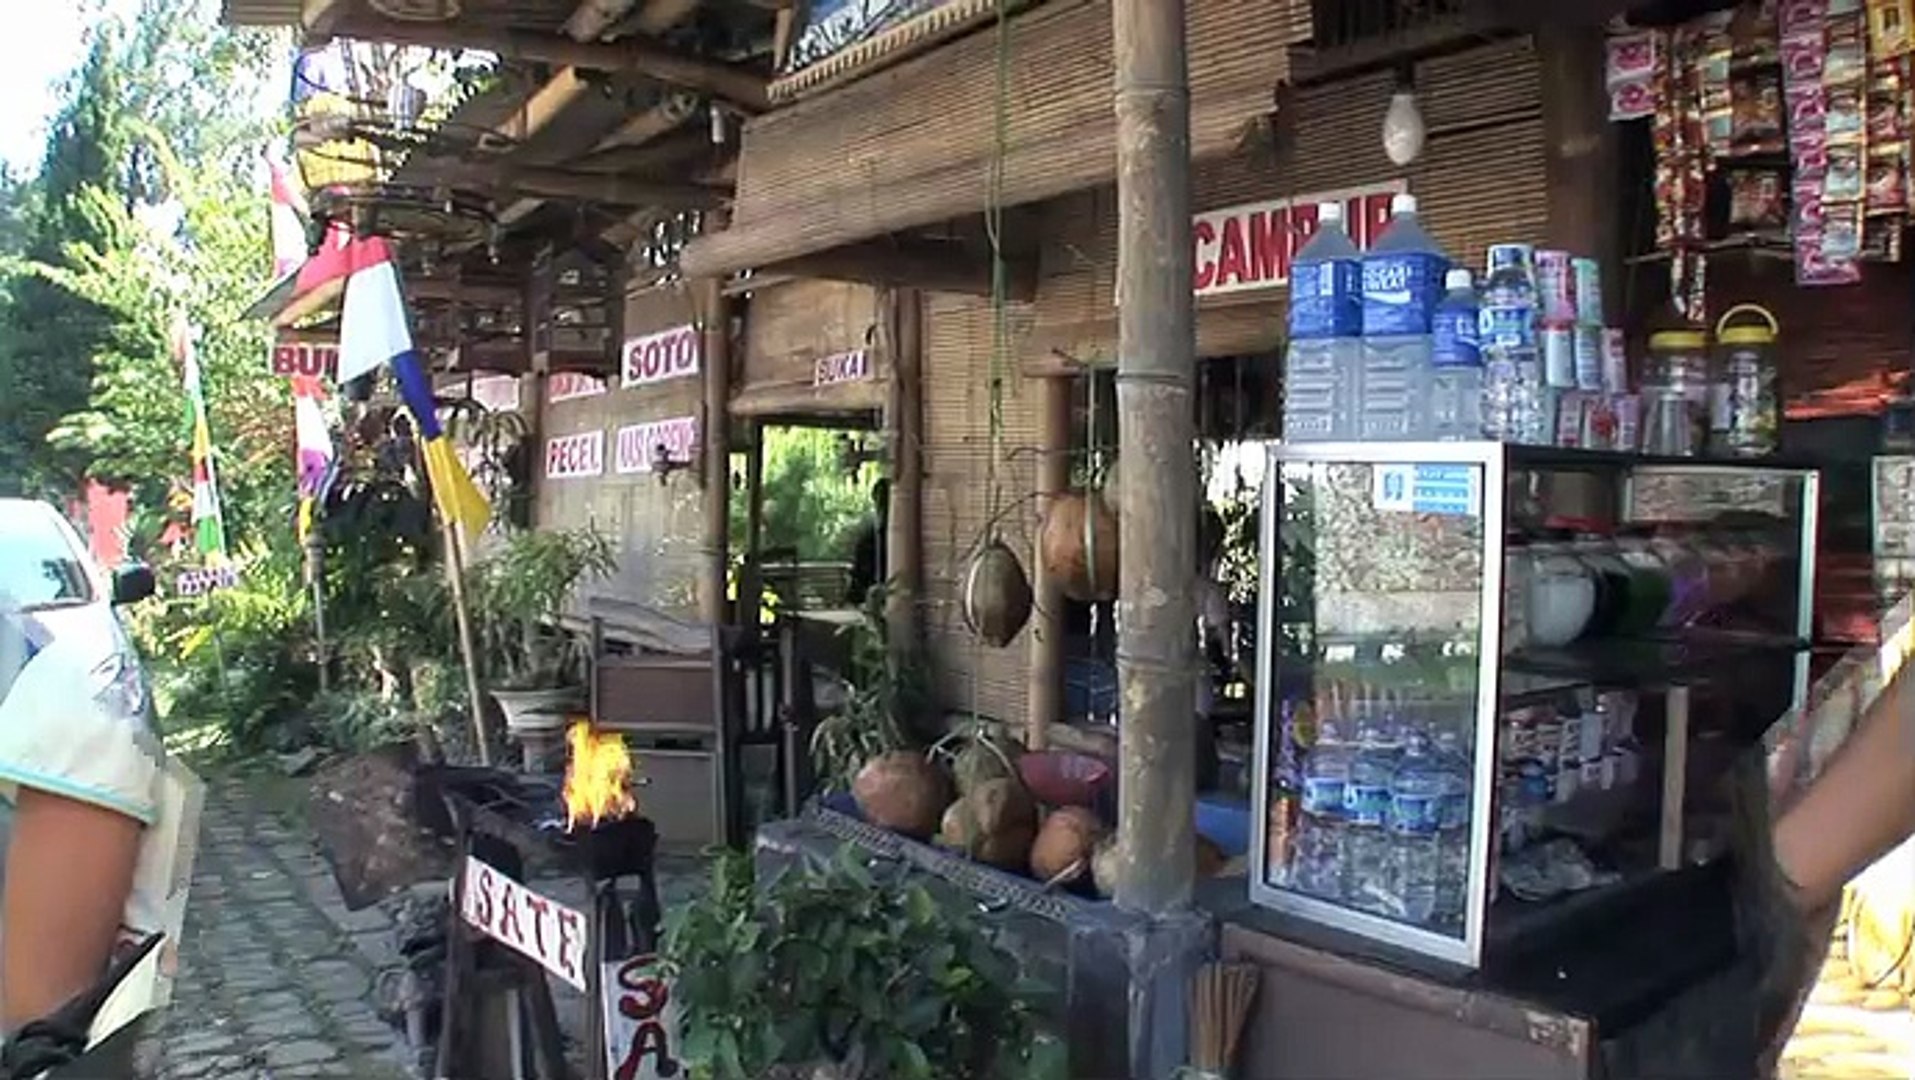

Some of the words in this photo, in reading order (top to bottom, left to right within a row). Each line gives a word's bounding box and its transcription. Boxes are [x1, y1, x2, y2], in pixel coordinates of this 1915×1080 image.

[629, 330, 697, 381] SOTO
[548, 435, 600, 473] PECEL
[477, 868, 578, 979] SATE
